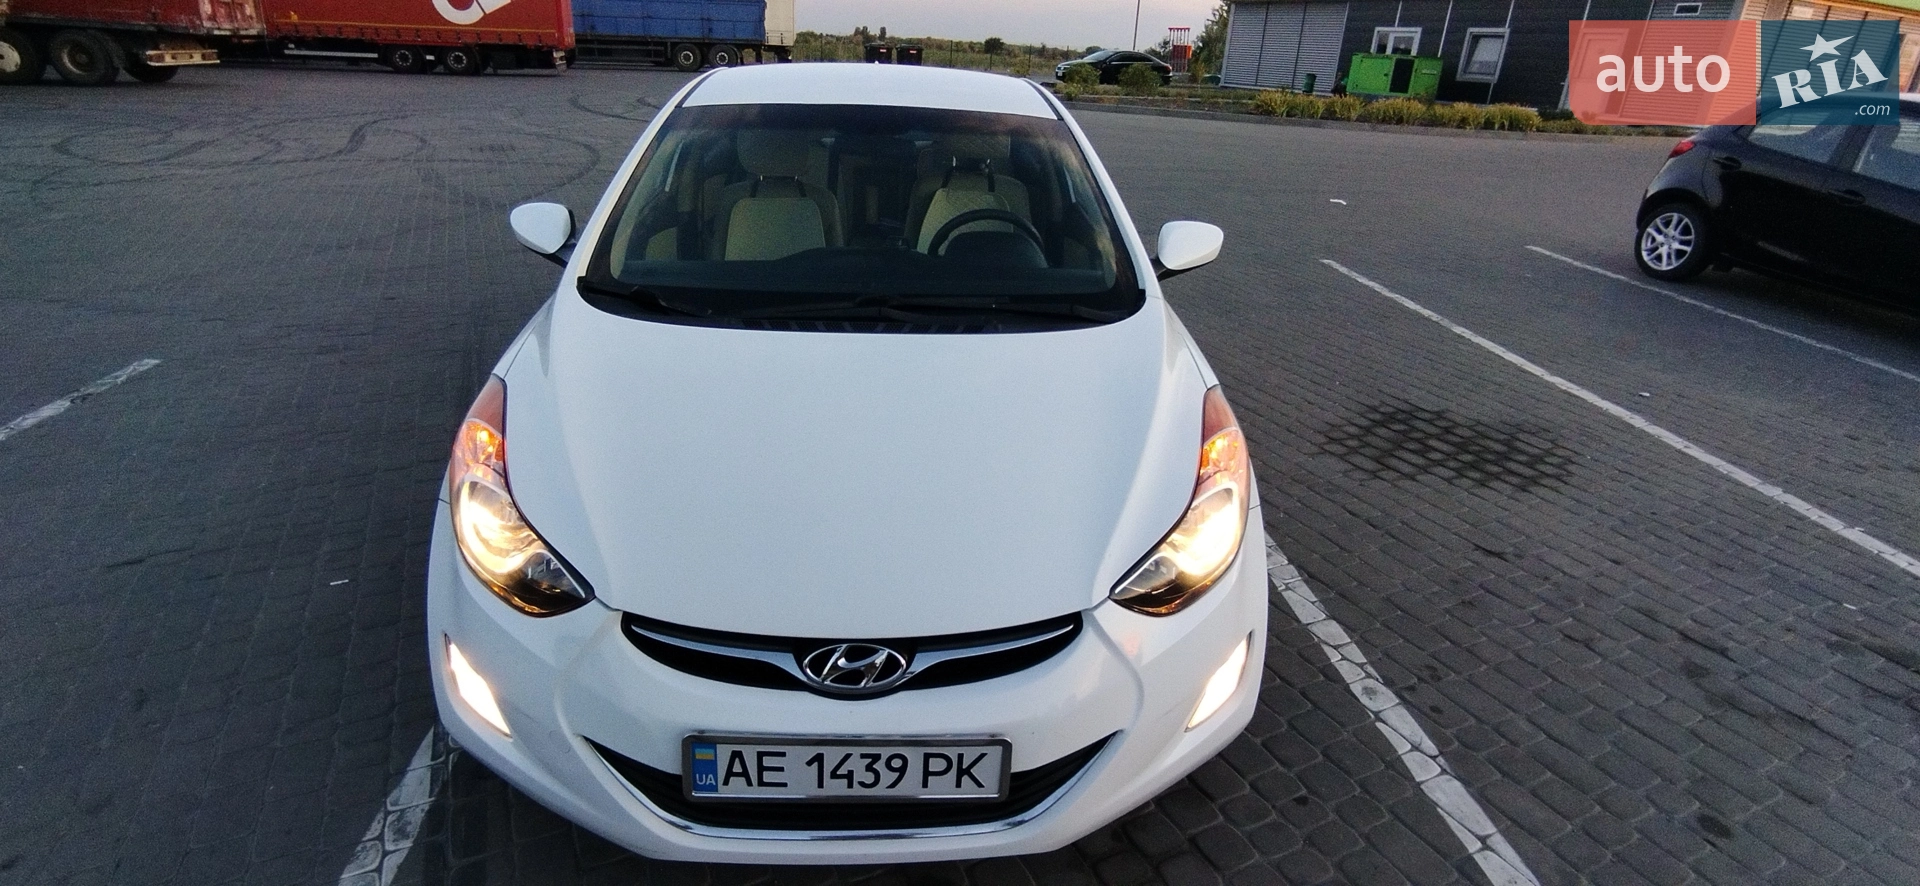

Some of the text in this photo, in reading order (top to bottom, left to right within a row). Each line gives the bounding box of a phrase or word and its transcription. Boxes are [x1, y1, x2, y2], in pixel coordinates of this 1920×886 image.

[695, 773, 716, 786] UA
[722, 750, 989, 789] AE 1439 PK
